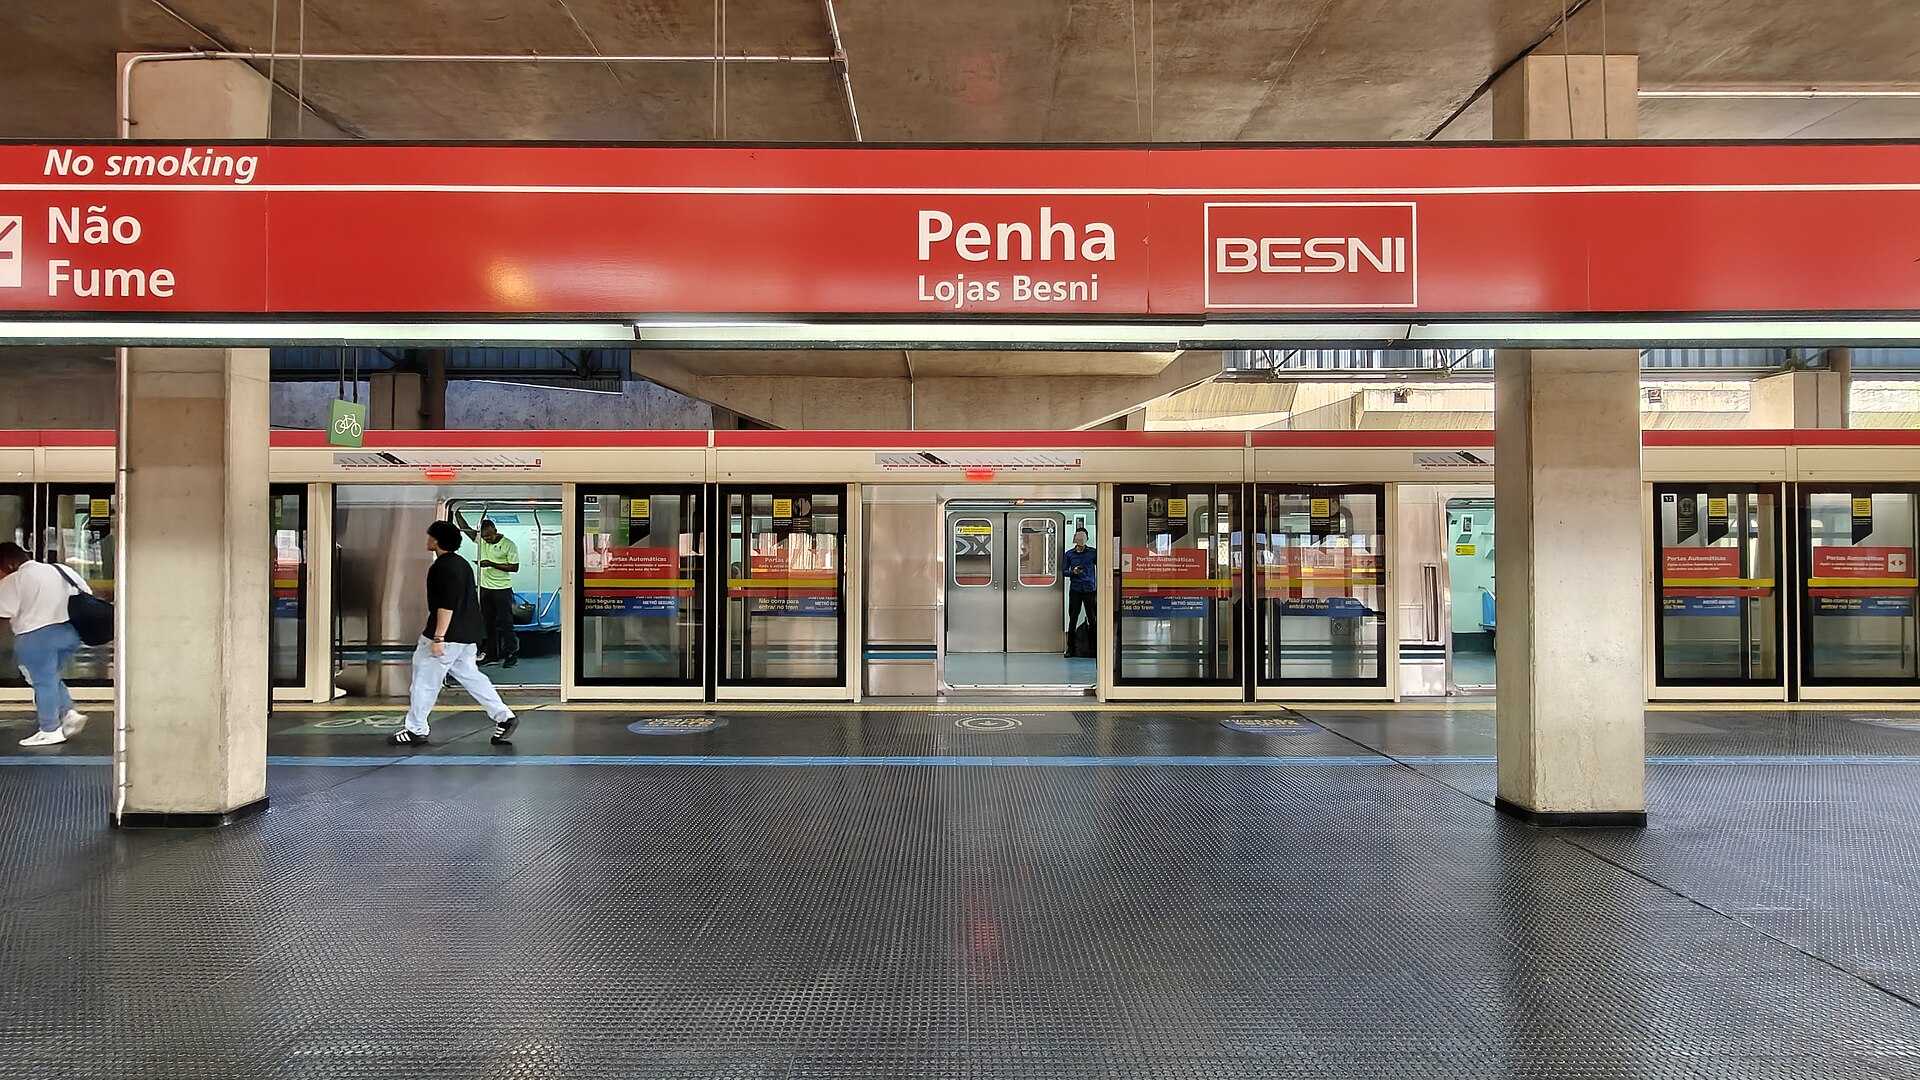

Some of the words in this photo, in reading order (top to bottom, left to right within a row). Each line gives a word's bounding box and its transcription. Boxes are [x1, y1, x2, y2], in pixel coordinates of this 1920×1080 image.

[44, 149, 93, 175] No
[105, 148, 258, 184] smoking
[49, 206, 141, 244] Não
[919, 207, 1115, 261] Penha
[1217, 238, 1405, 272] BESNI
[49, 260, 175, 297] Fume
[918, 275, 1000, 308] Lojas
[1012, 275, 1098, 301] Besni
